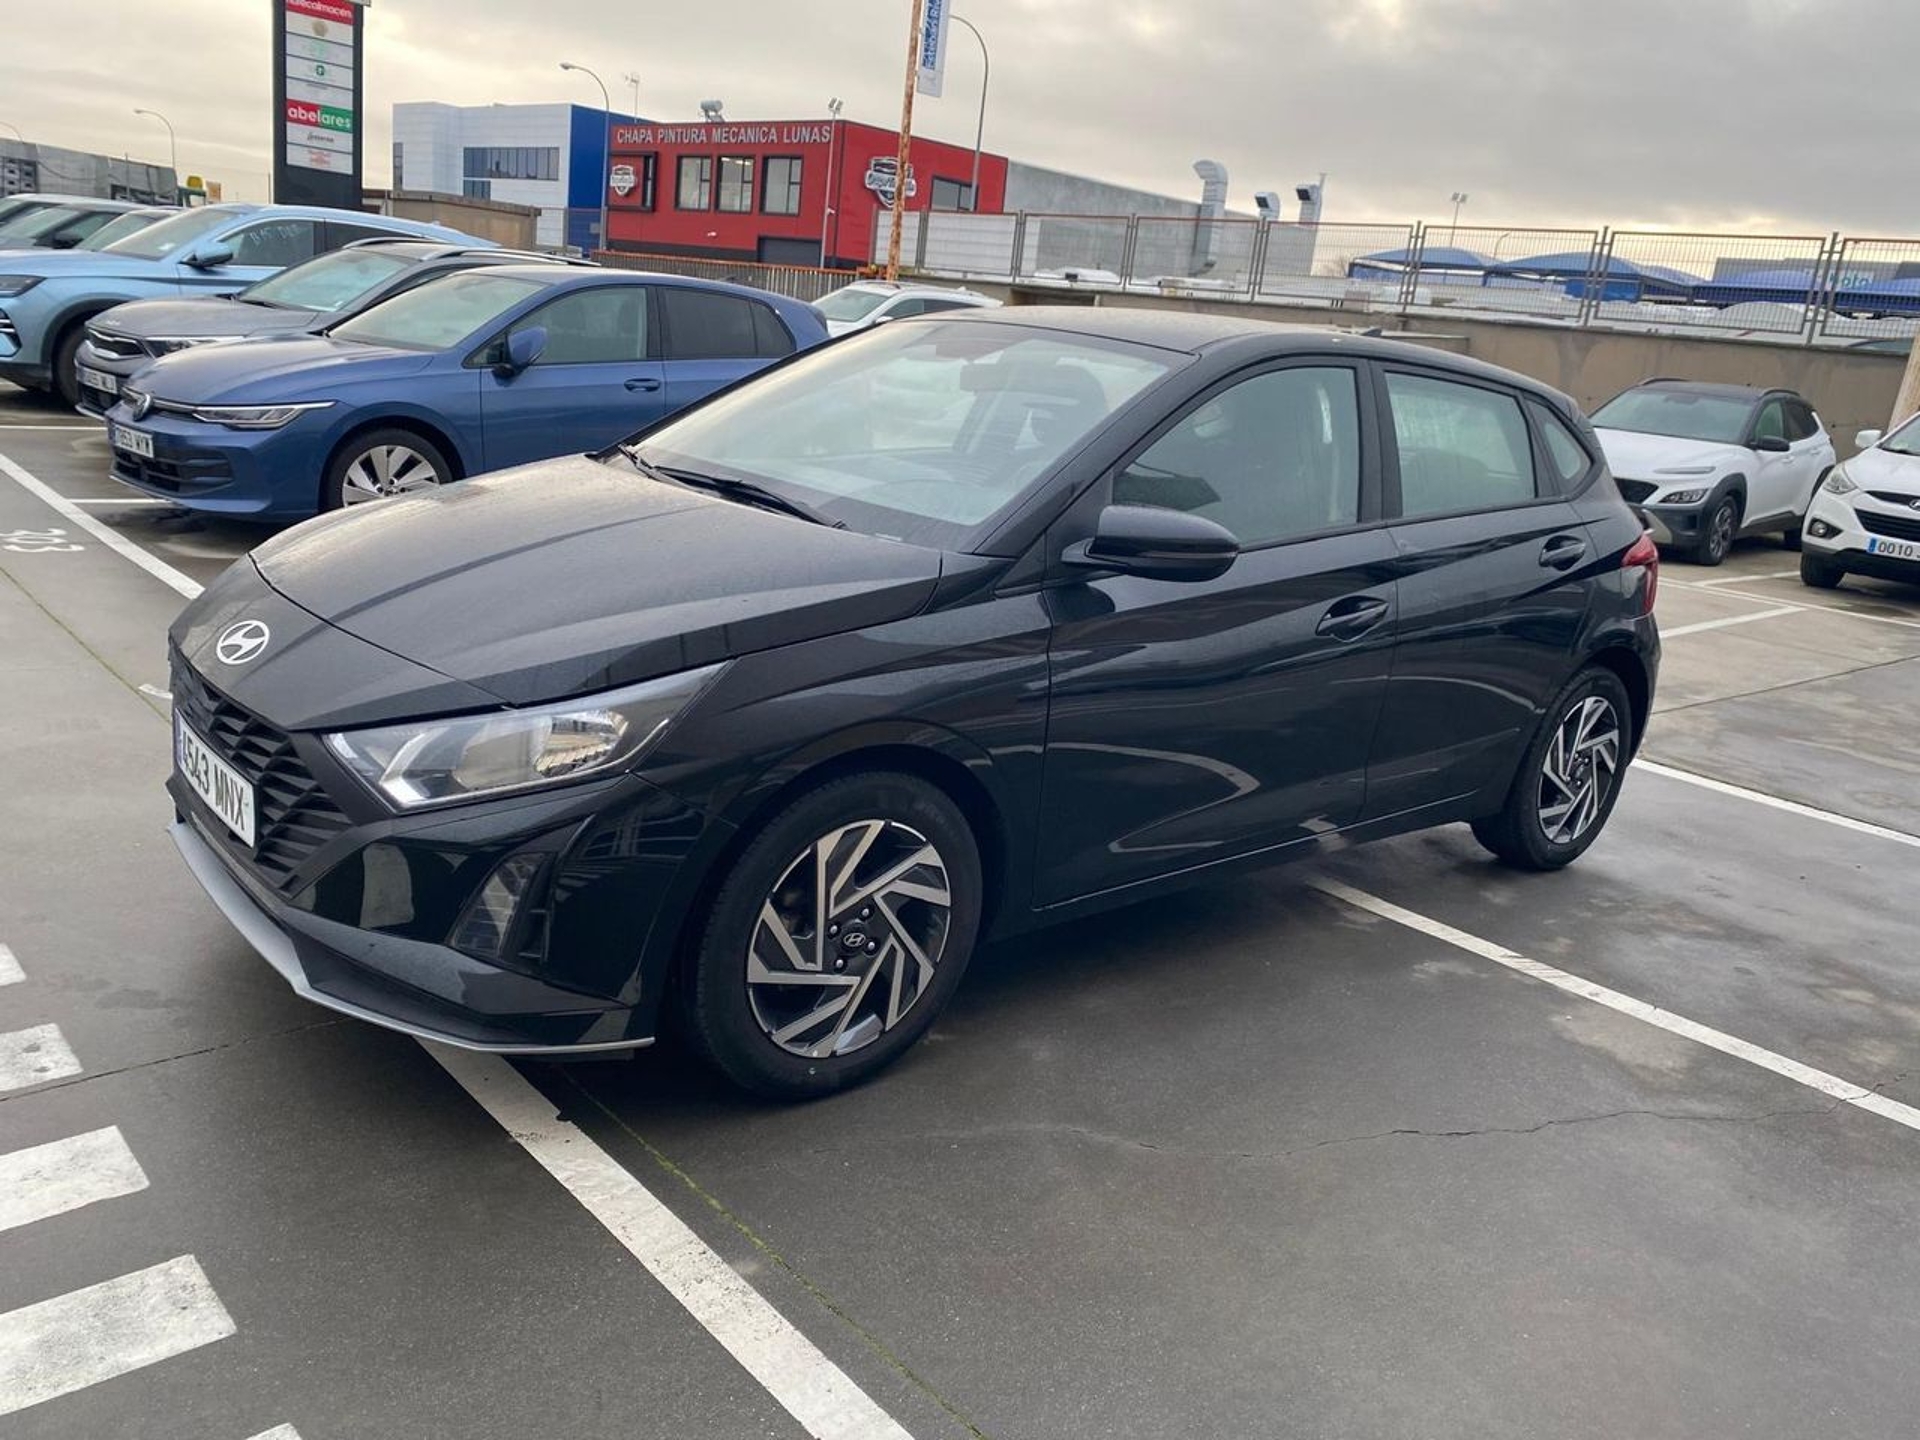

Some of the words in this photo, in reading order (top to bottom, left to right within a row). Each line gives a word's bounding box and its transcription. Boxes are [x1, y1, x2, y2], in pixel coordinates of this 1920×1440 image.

[288, 107, 351, 128] abelares
[617, 128, 652, 144] CHAPA
[657, 127, 707, 143] PINTURA
[711, 126, 778, 142] MECANICA
[783, 125, 831, 142] LUNAS
[1878, 541, 1913, 557] 0010
[214, 763, 245, 831] MNX
